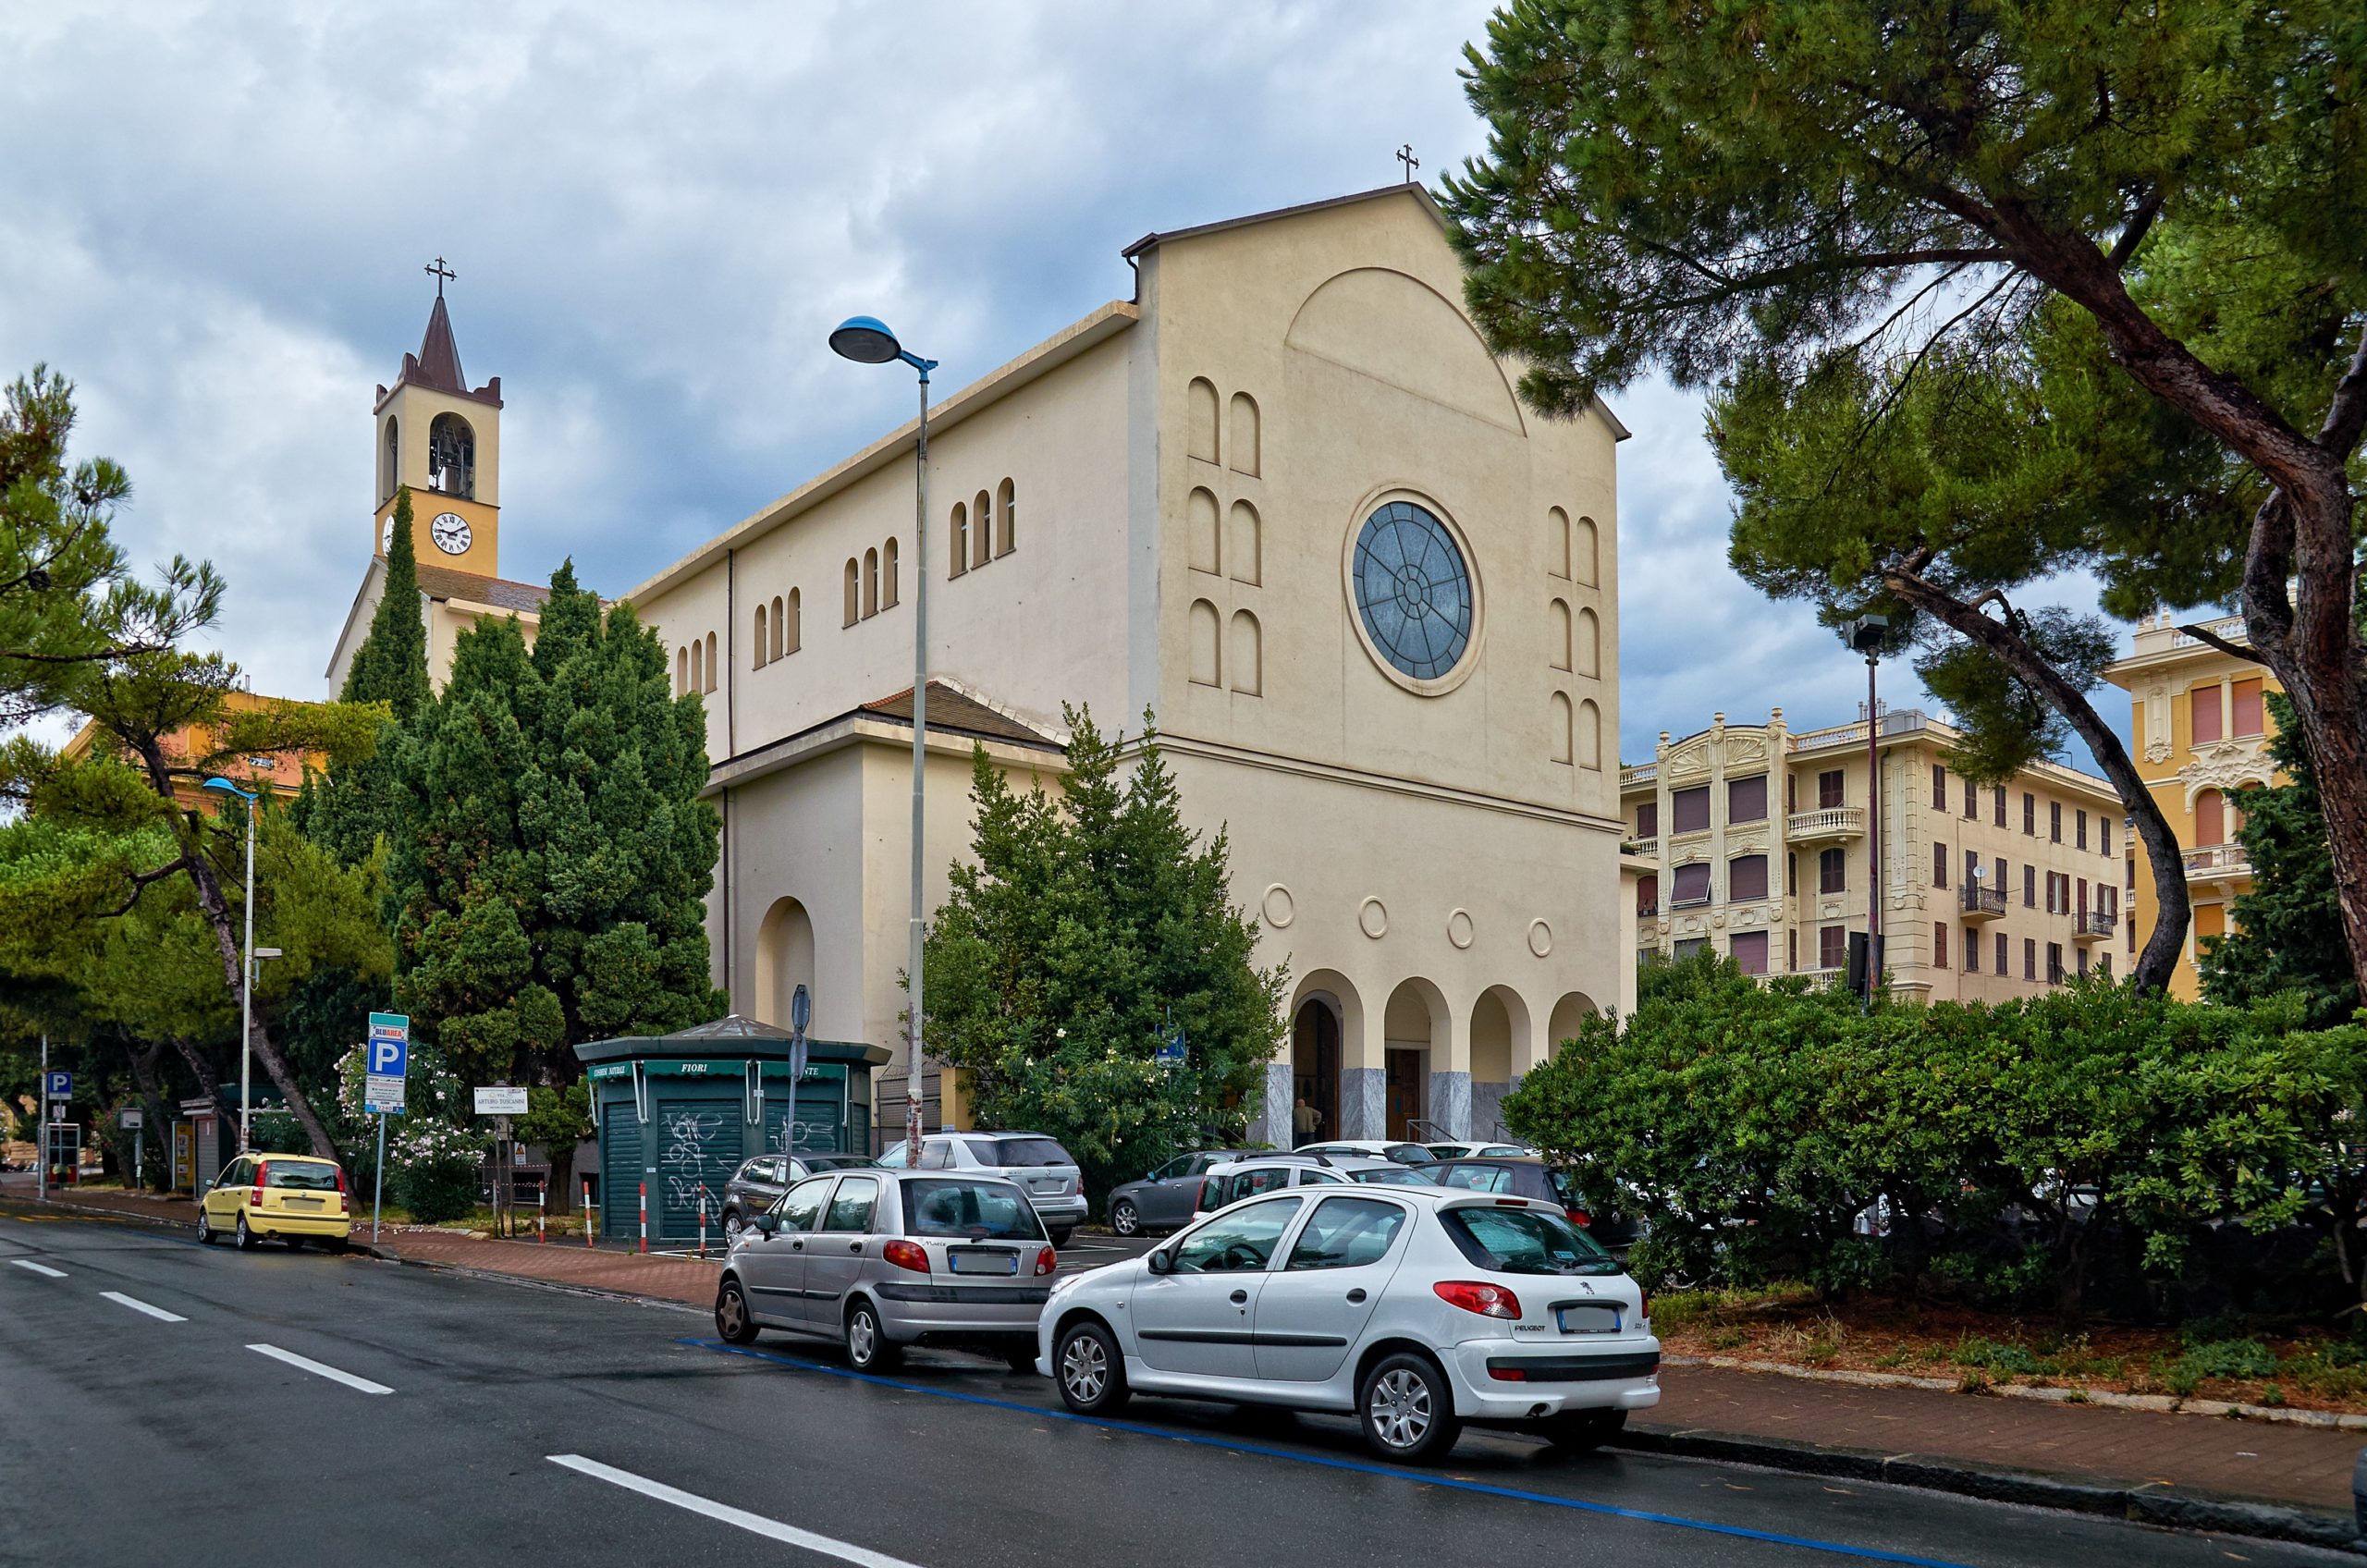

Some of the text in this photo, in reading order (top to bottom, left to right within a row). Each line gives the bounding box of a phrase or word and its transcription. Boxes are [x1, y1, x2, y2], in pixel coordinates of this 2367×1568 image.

[375, 1042, 399, 1072] P
[681, 1063, 707, 1072] FIORI
[804, 1067, 818, 1075] NTE
[53, 1074, 67, 1091] P
